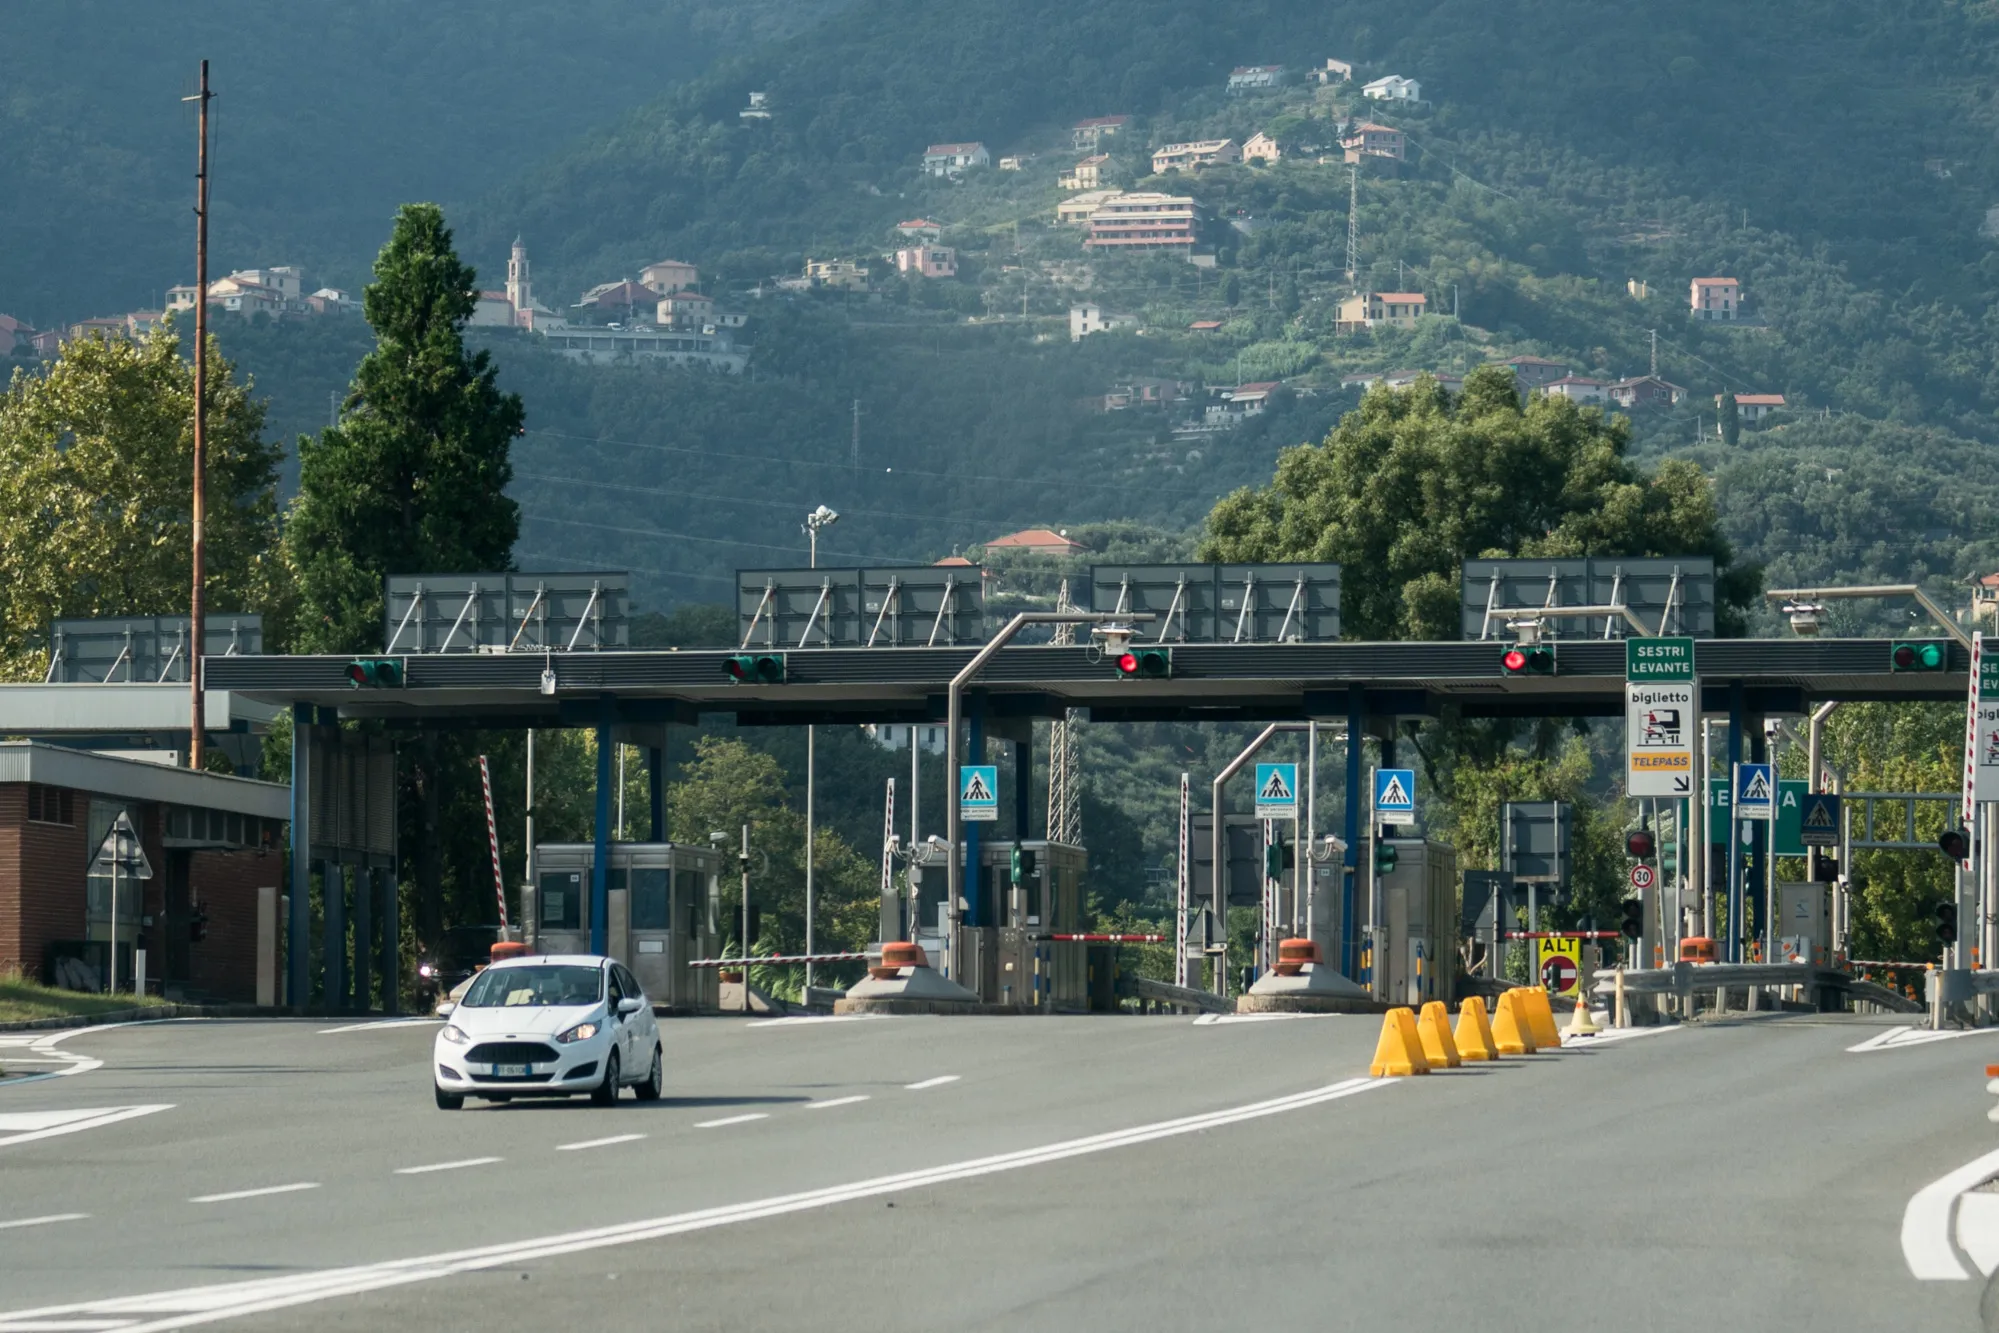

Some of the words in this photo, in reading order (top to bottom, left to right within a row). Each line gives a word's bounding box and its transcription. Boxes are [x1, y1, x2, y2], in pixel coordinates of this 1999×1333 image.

[1637, 646, 1685, 657] SESTRI
[1632, 662, 1690, 673] LEVANTE
[1632, 692, 1689, 705] biglietto
[1633, 757, 1688, 766] TELEPASS
[1636, 871, 1649, 883] 30
[1543, 938, 1576, 952] ALT
